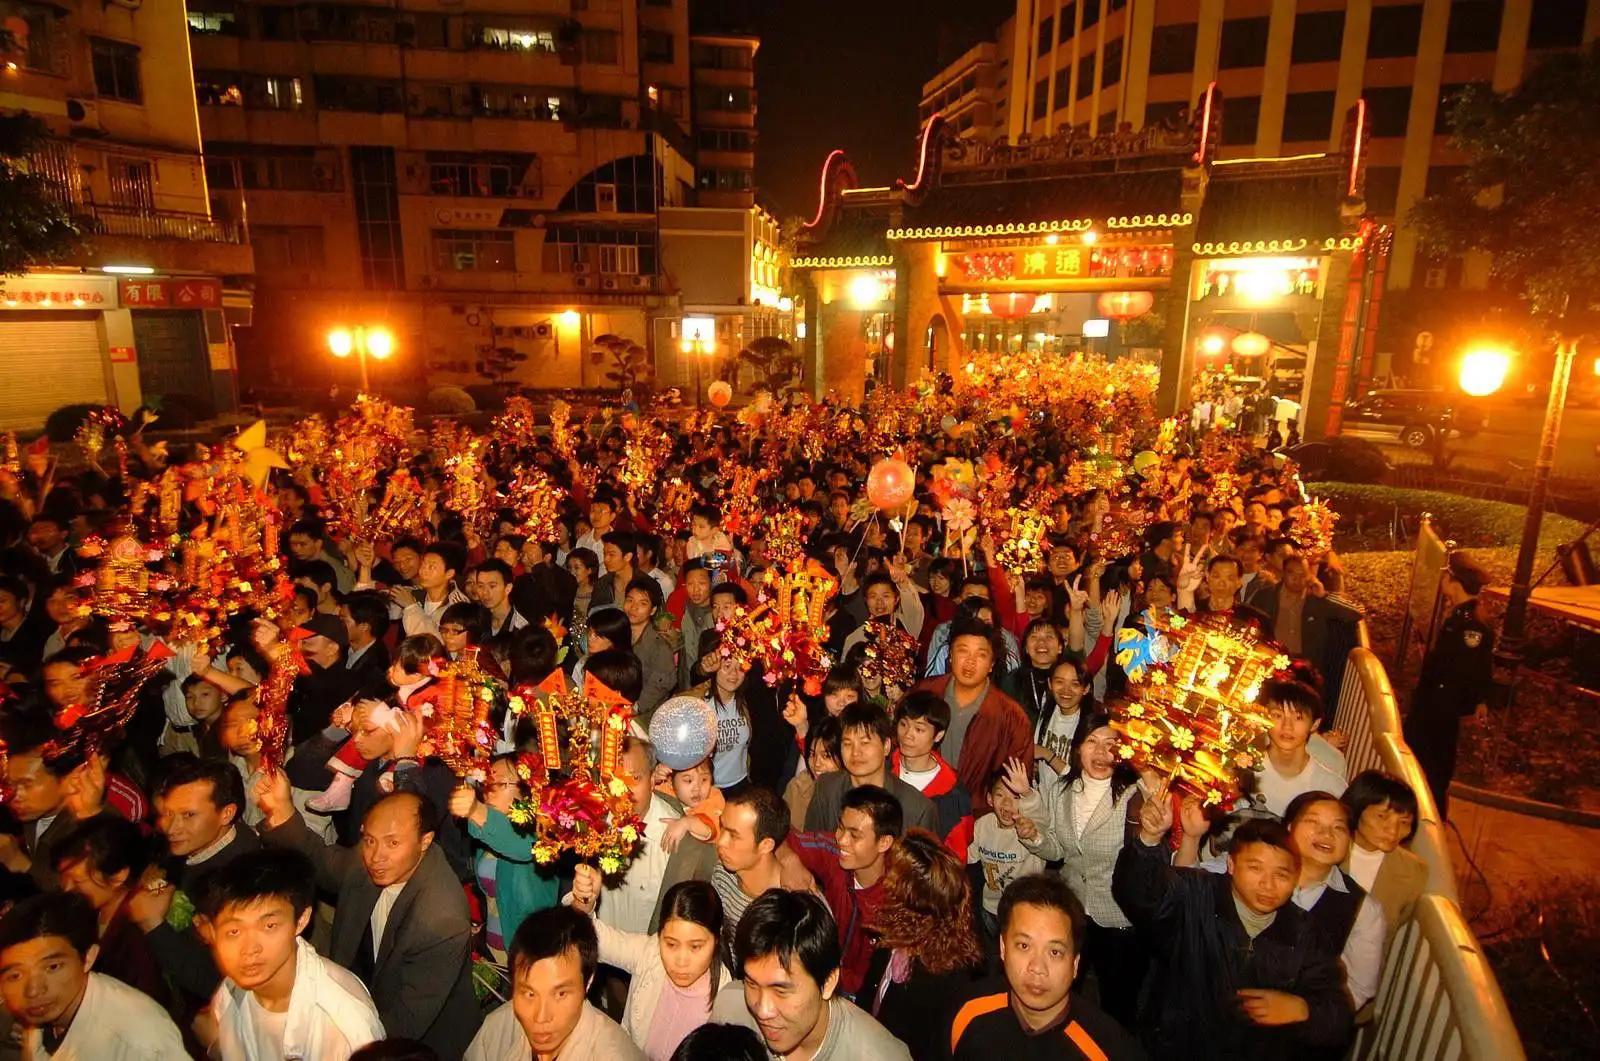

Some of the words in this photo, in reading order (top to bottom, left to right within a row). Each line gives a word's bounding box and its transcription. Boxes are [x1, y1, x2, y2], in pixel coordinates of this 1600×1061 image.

[126, 285, 215, 302] 有限公司
[997, 851, 1017, 861] Cup
